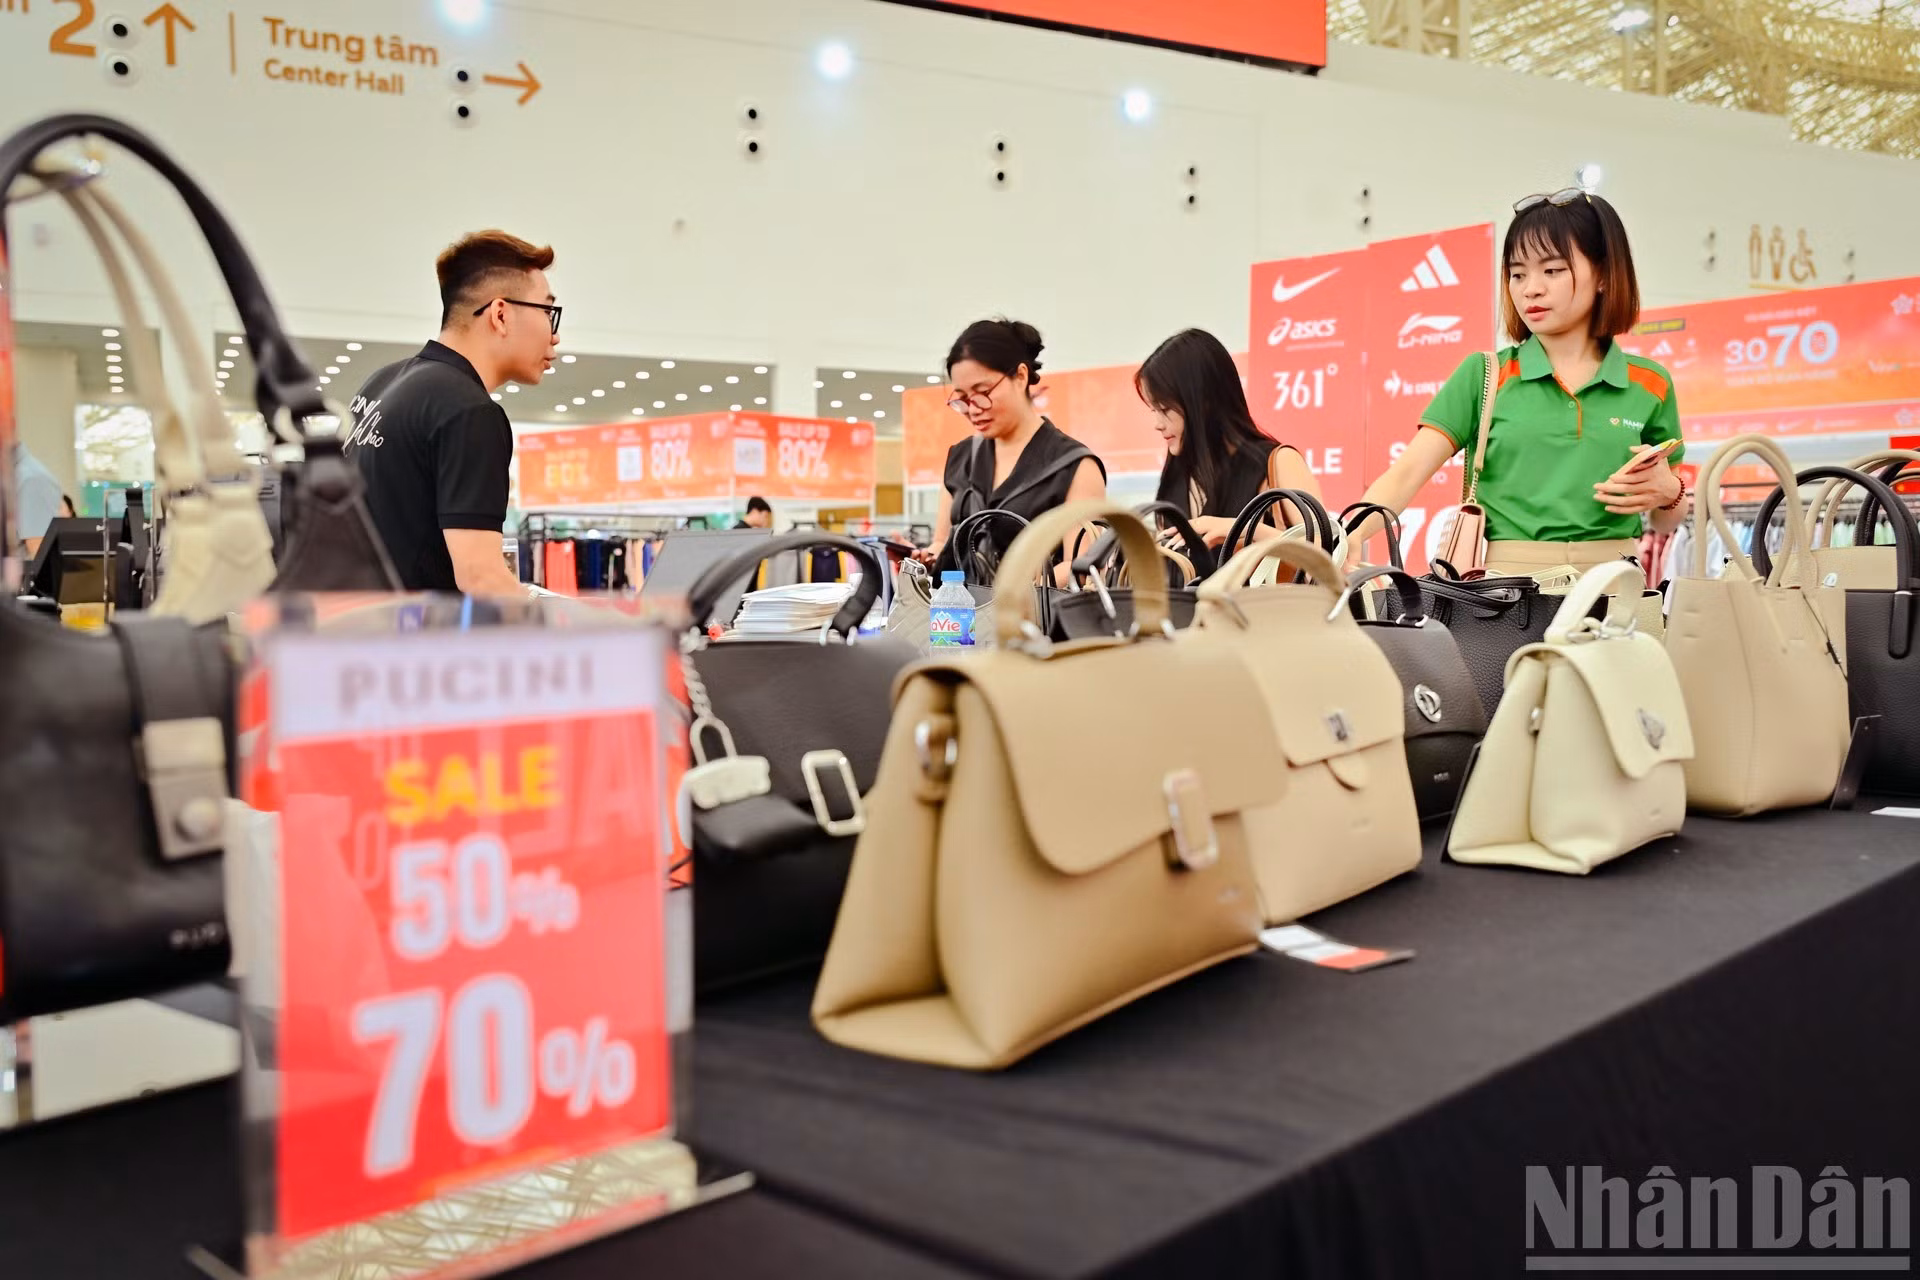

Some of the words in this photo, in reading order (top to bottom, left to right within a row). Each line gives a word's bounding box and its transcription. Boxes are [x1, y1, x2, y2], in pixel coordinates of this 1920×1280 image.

[49, 0, 96, 57] 2
[262, 16, 366, 64] Trung
[373, 34, 439, 66] tâm
[264, 58, 350, 88] Center
[355, 69, 404, 95] Hall
[1289, 318, 1337, 340] asics
[650, 440, 693, 480] 80%
[778, 438, 830, 478] 80%
[1306, 448, 1343, 475] LE
[930, 617, 961, 632] aVie
[337, 651, 596, 713] PUCINI
[386, 746, 560, 826] SALE
[389, 832, 580, 960] 50%
[351, 972, 638, 1180] 70%
